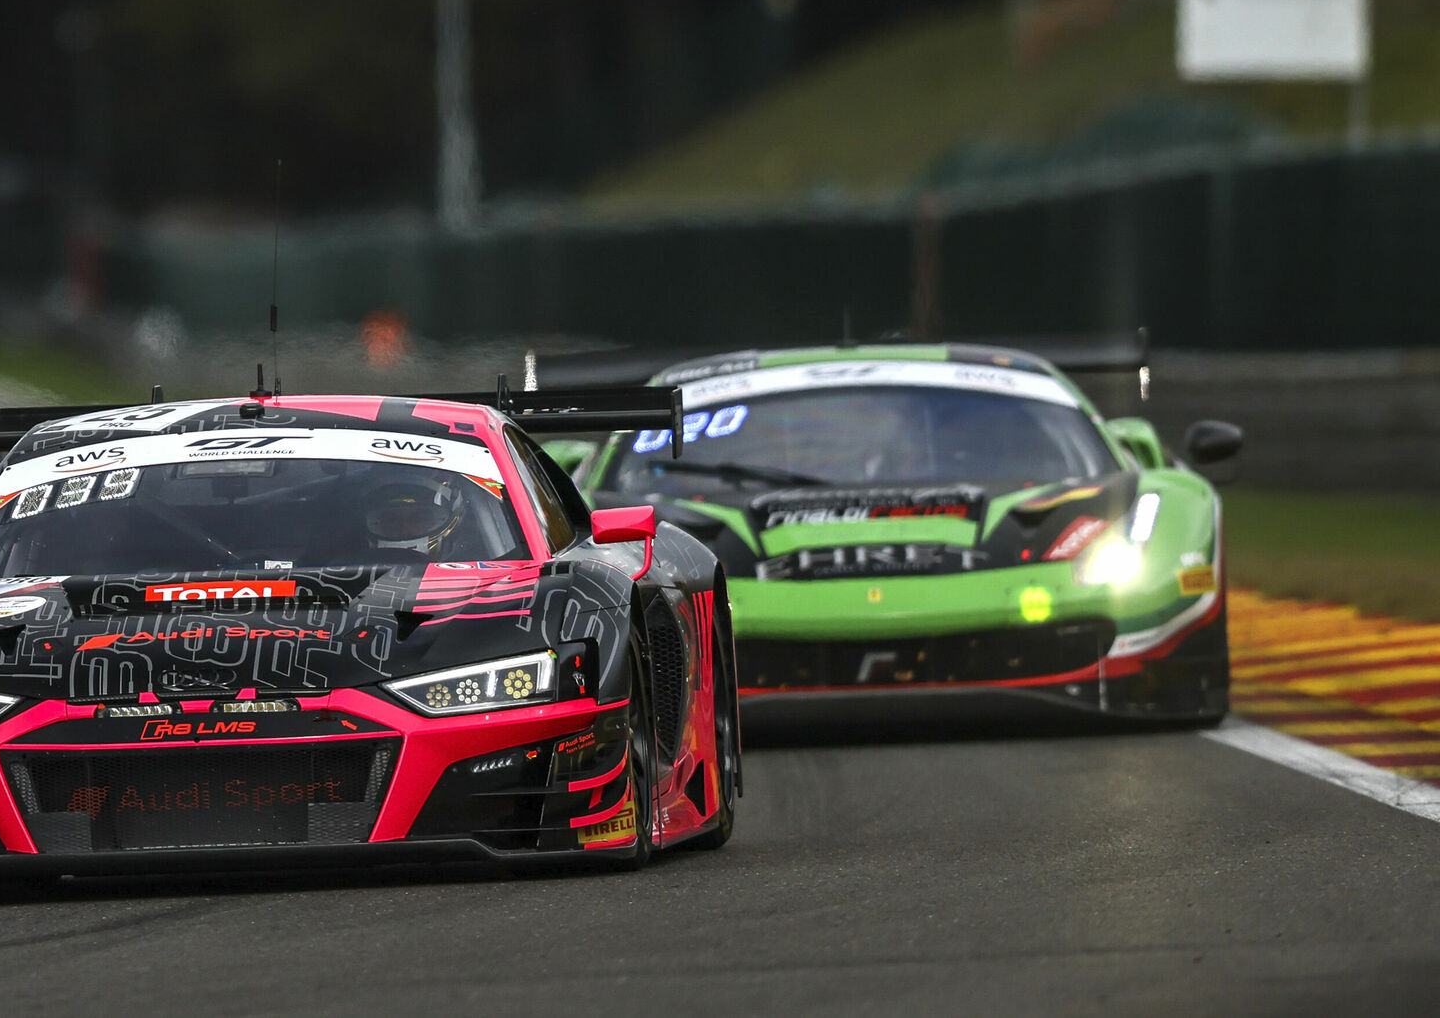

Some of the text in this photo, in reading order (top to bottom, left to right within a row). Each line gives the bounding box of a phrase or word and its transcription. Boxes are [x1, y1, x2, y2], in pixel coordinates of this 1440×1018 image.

[184, 435, 314, 451] GT
[370, 437, 443, 456] aws
[54, 446, 125, 469] aws
[188, 448, 296, 458] WORLD CHALLENGE
[153, 586, 272, 601] TOTAL
[126, 626, 331, 643] Audi Sport
[154, 720, 257, 736] R8 LMS
[578, 732, 595, 743] Sport
[116, 778, 344, 813] Audi Sport
